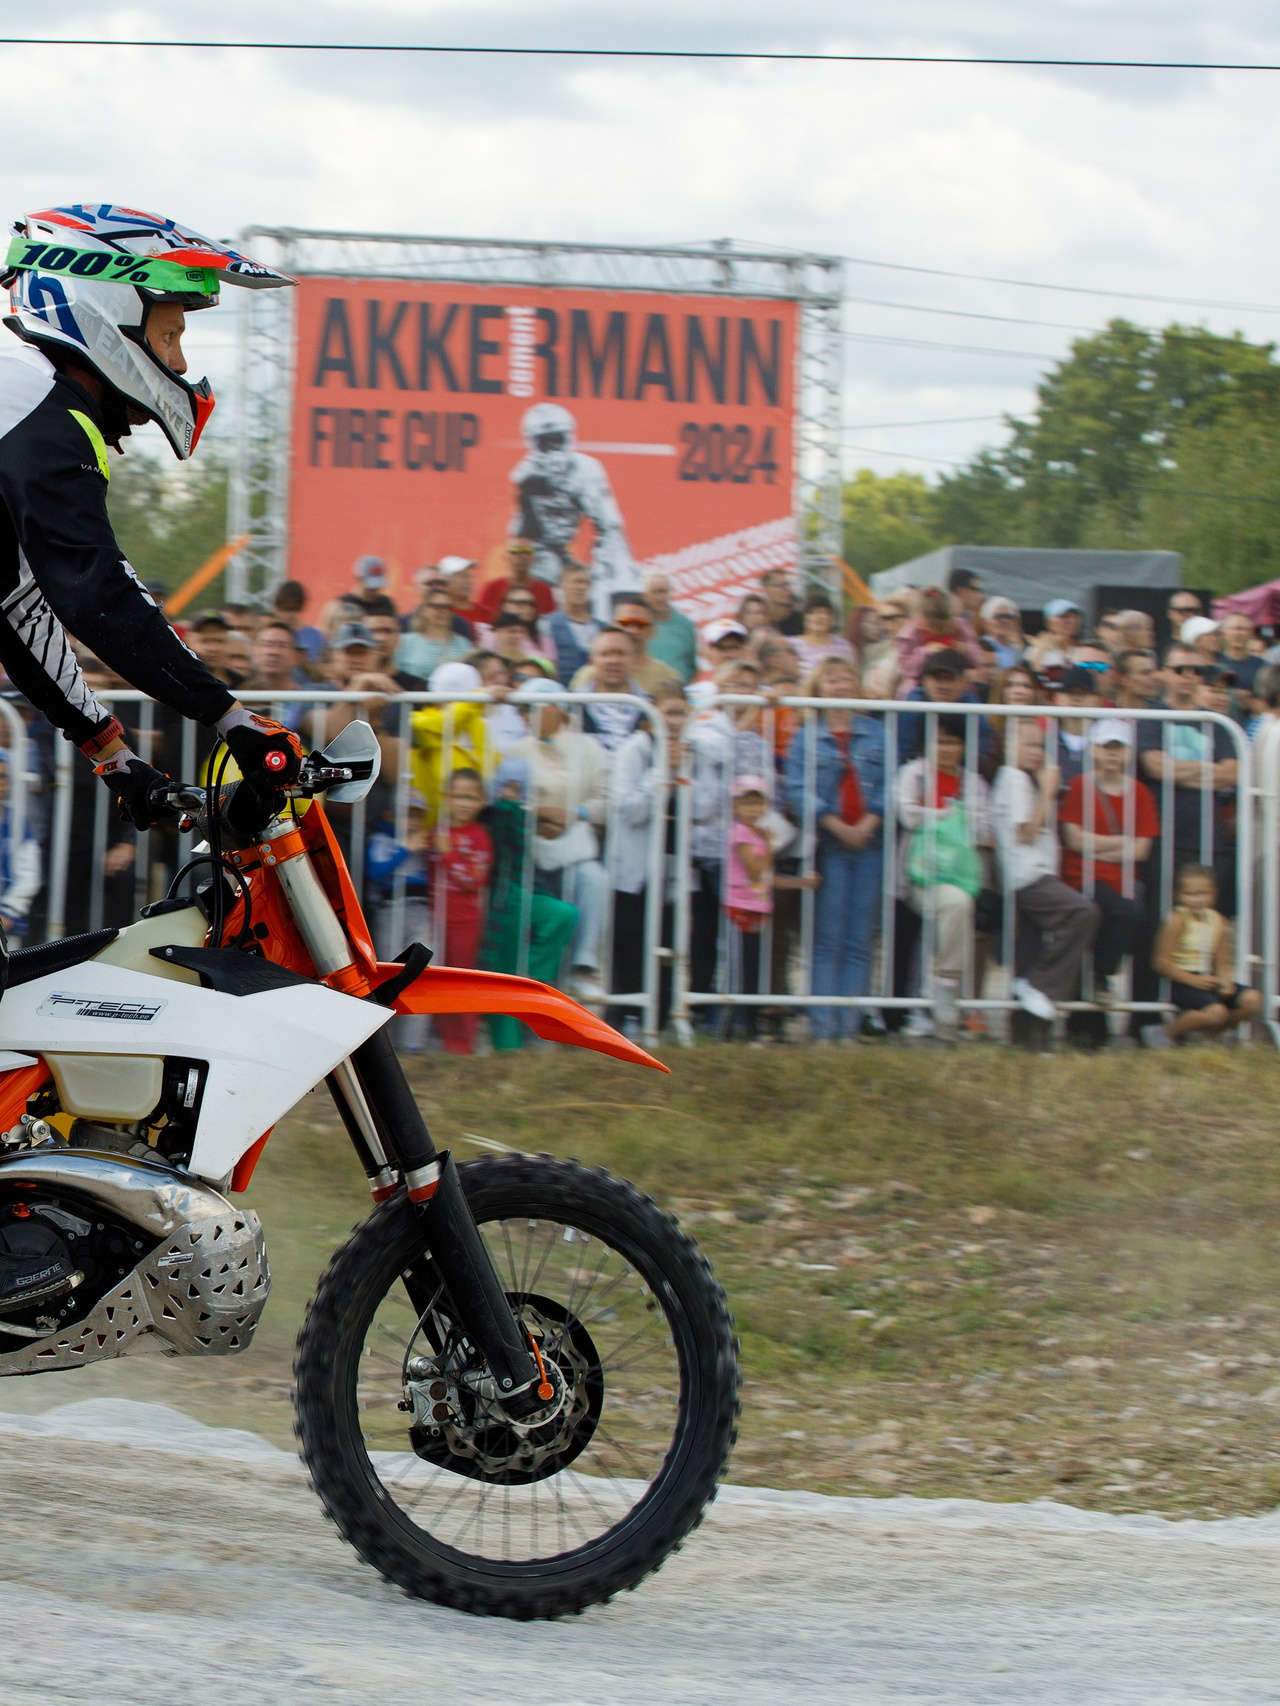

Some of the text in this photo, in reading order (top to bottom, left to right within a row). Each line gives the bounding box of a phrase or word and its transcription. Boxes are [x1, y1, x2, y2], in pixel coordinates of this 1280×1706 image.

[19, 244, 153, 282] 100%
[312, 297, 784, 406] AKKERMANN
[310, 406, 478, 472] FIRE CUP
[679, 421, 779, 485] 2024
[103, 759, 119, 773] FOX
[48, 996, 162, 1013] P-TECH
[91, 1010, 150, 1020] www.p-tech.ee
